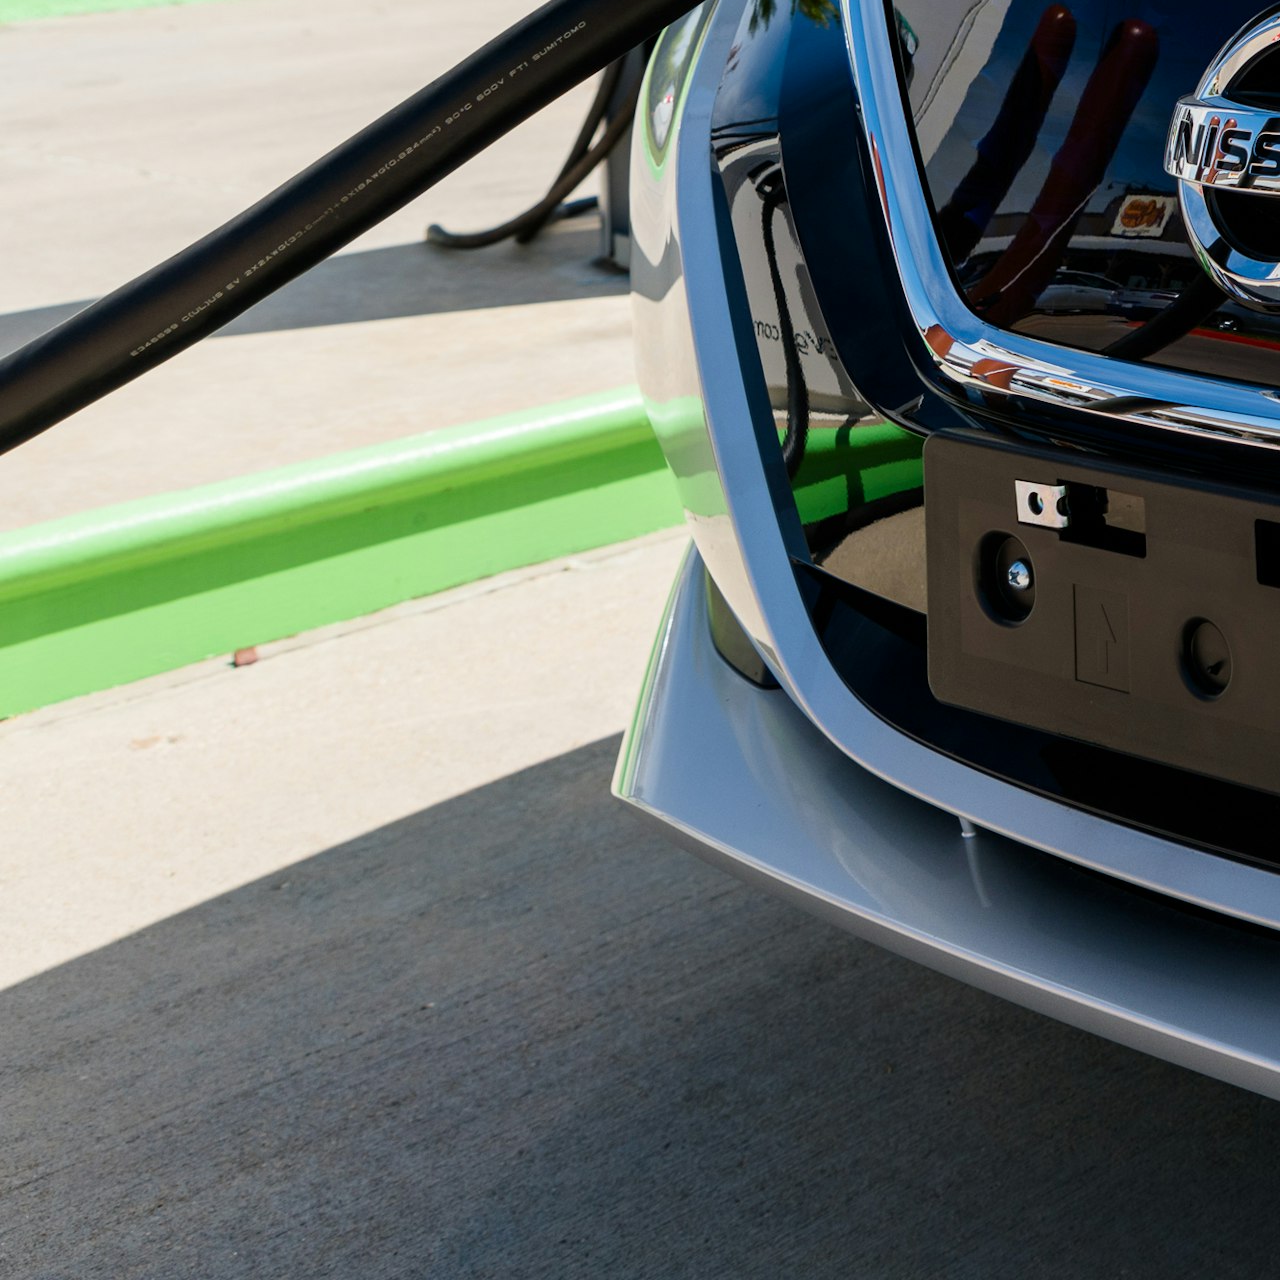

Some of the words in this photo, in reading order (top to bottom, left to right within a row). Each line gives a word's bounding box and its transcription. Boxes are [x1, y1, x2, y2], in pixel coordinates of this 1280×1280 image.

[225, 277, 240, 291] EV
[476, 78, 505, 102] 600V
[531, 20, 587, 61] SUMITOMO
